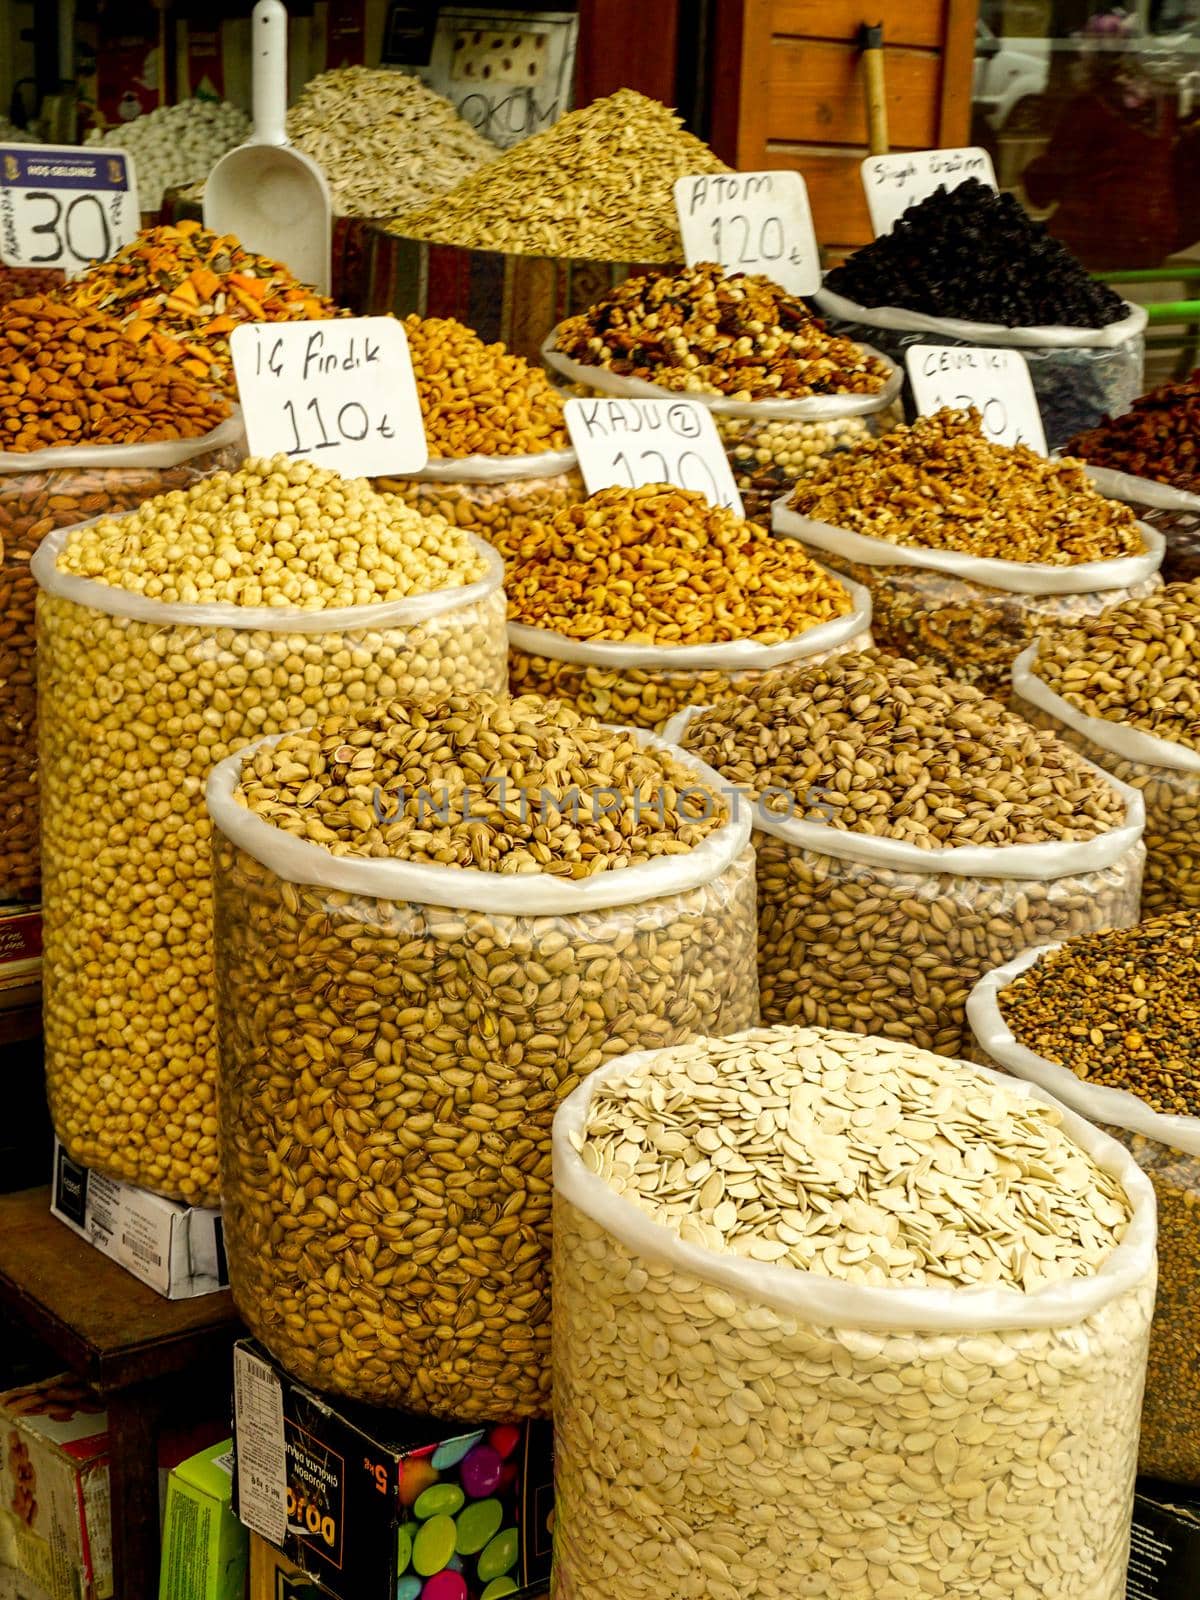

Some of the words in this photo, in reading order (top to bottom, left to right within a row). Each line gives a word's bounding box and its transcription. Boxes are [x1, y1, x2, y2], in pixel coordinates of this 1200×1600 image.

[690, 175, 774, 216] ATOM
[25, 192, 111, 263] 30
[578, 401, 663, 438] KAJU
[286, 1486, 336, 1548] DOJO
